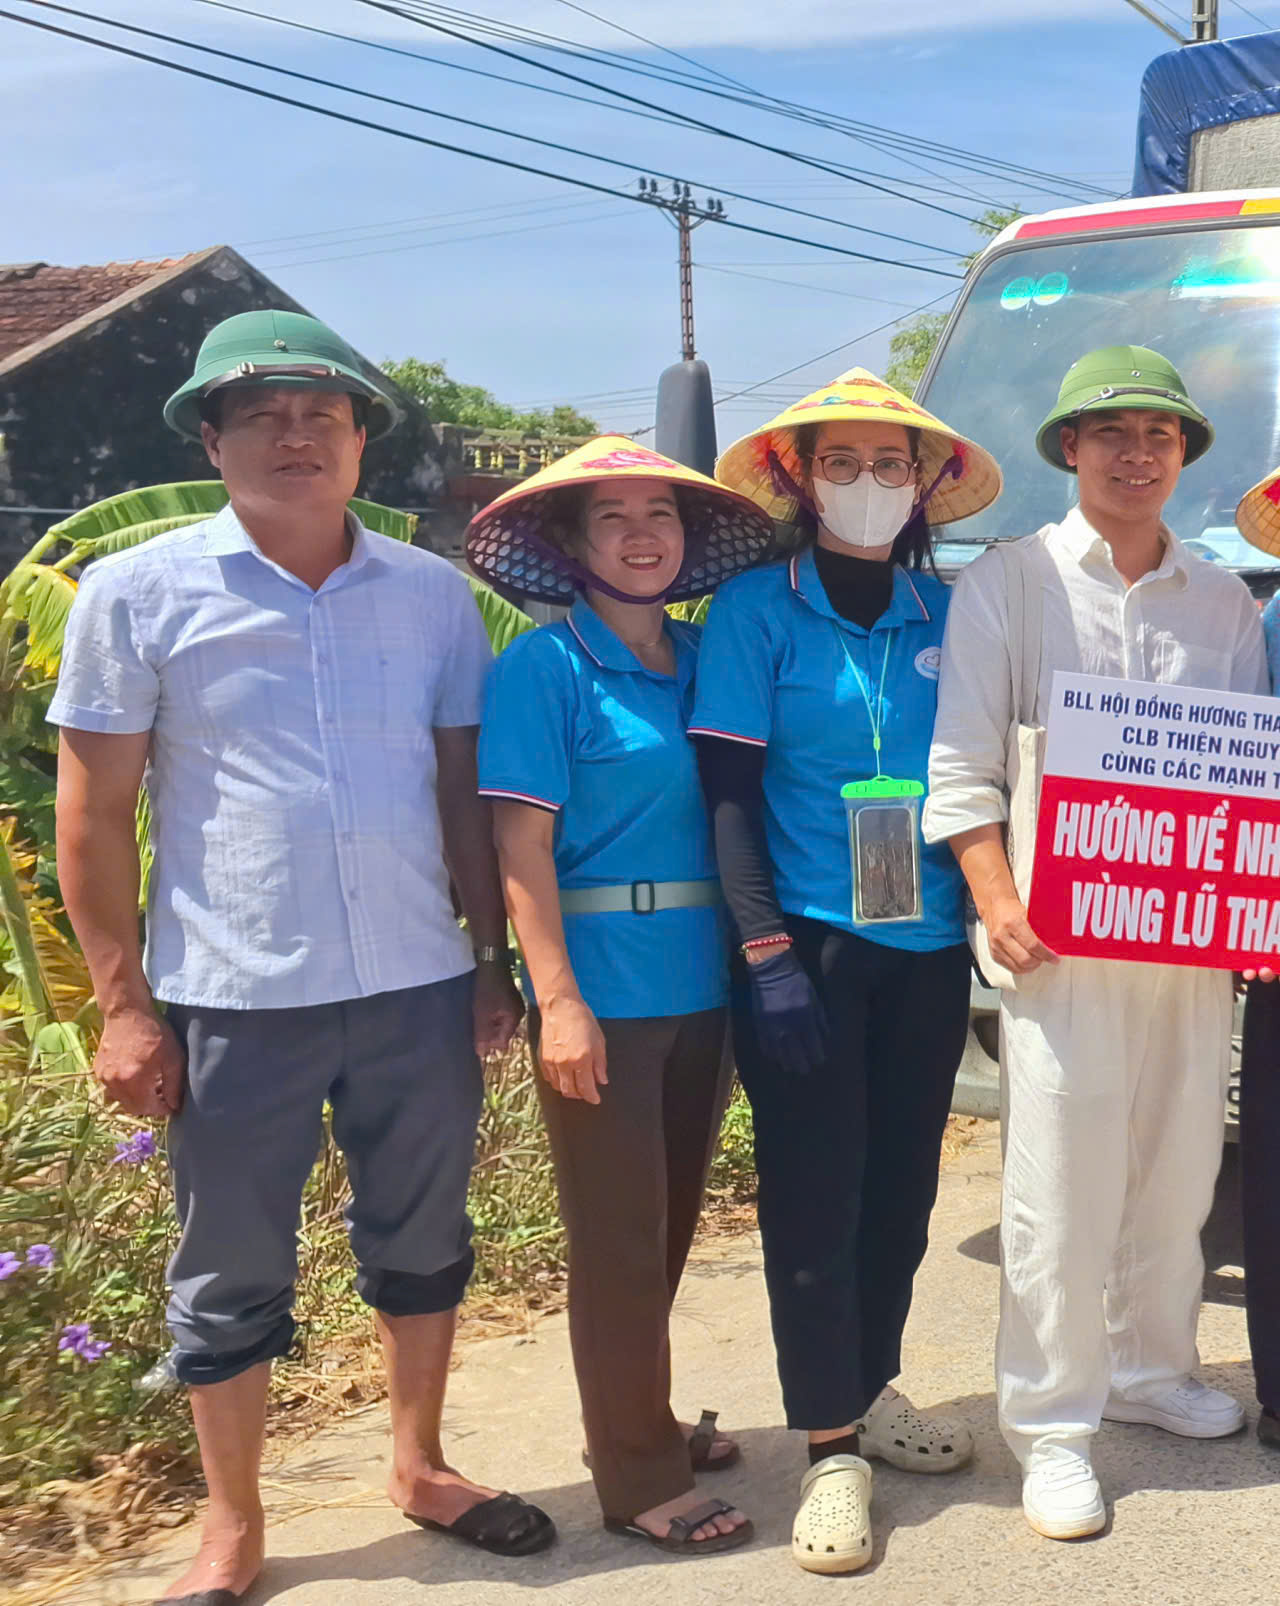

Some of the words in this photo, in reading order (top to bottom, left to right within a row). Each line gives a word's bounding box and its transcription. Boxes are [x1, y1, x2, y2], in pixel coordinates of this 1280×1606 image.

[1063, 689, 1094, 711] BLL
[1099, 692, 1130, 718] HỘI
[1188, 704, 1248, 729] HƯƠNG
[1122, 726, 1159, 747] CLB
[1166, 730, 1222, 757] THIỆN
[1101, 750, 1156, 776] CÙNG
[1162, 757, 1203, 781] CÁC
[1207, 764, 1267, 789] MẠNH
[1052, 795, 1176, 867] HƯỚNG
[1186, 799, 1230, 872] VỀ
[1071, 871, 1165, 944] VÙNG
[1171, 882, 1218, 948] LŨ
